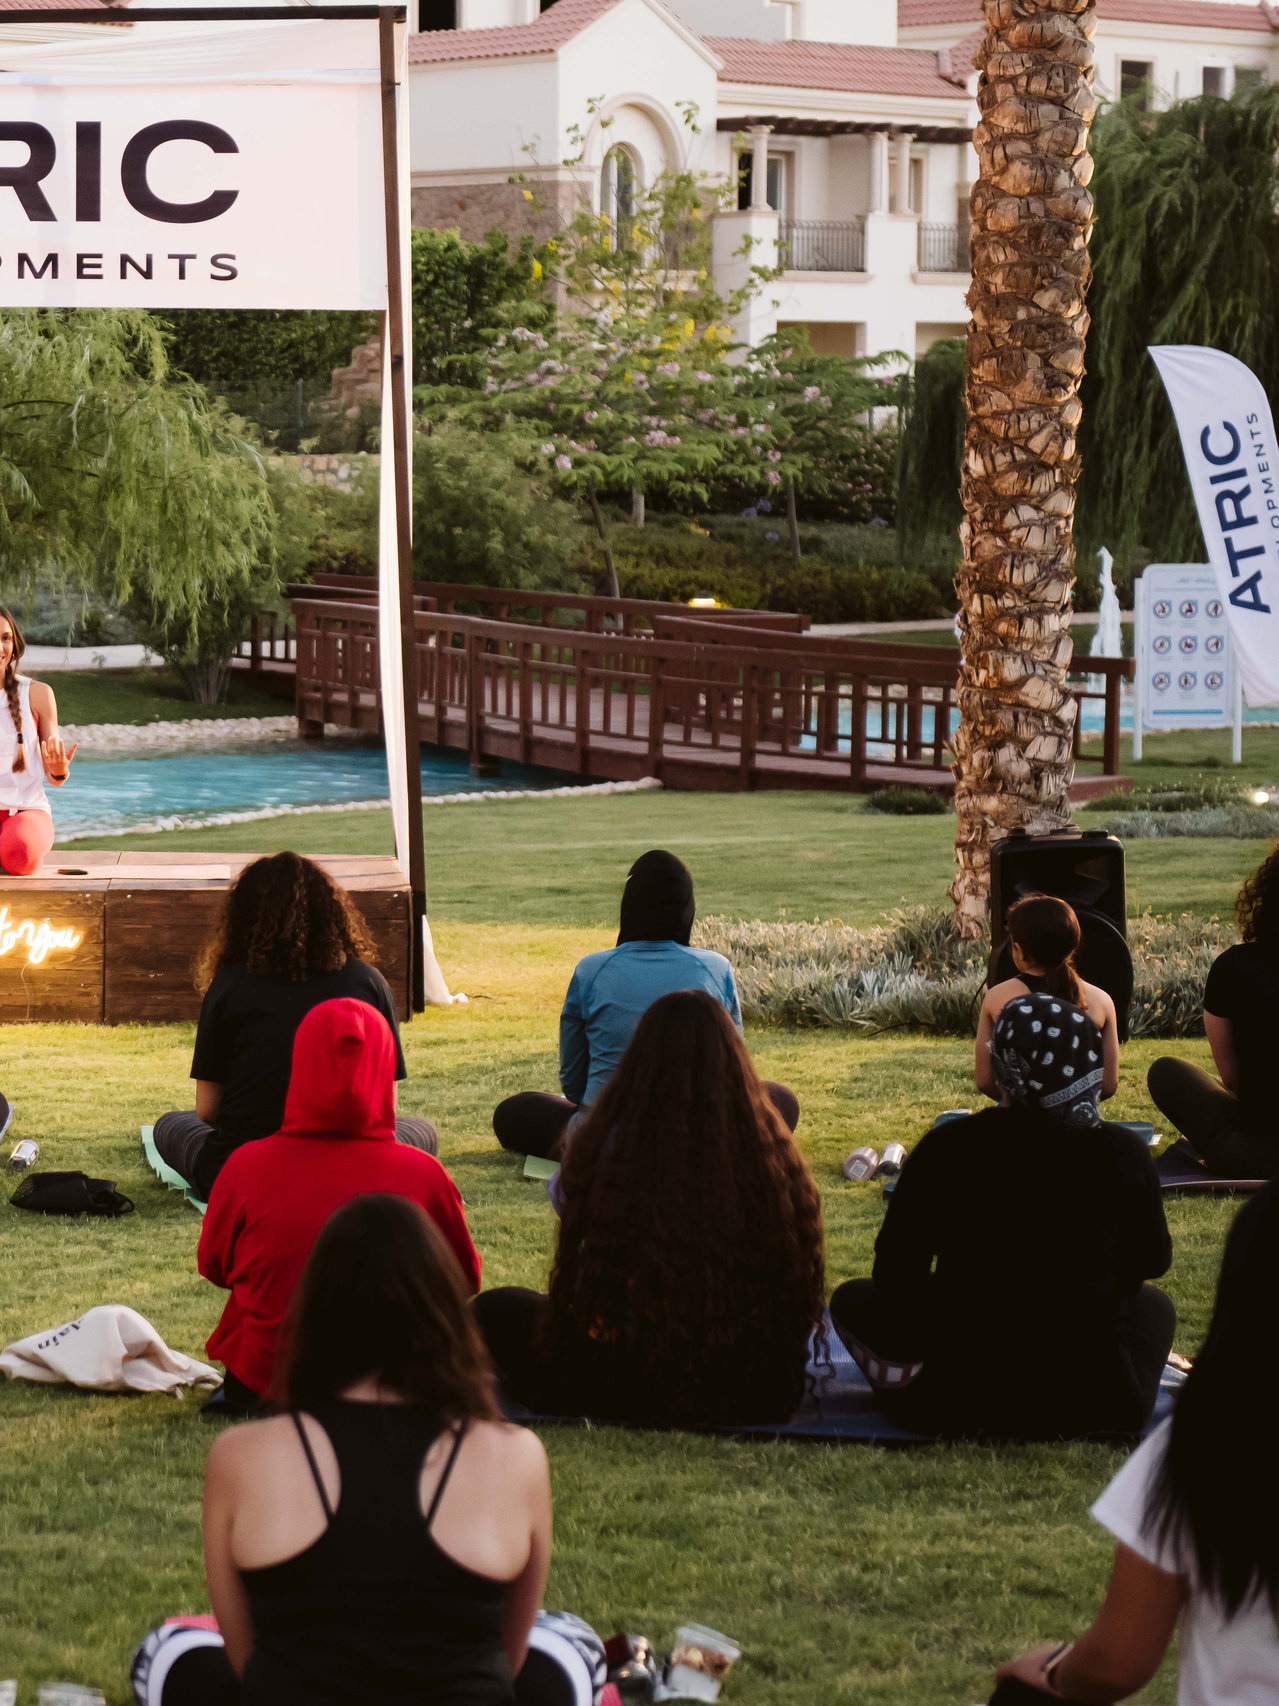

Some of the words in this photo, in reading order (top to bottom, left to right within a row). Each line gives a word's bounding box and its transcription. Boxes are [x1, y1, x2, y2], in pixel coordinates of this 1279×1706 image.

[1200, 420, 1272, 614] ATRIC
[1246, 412, 1279, 560] OPMENTS
[16, 920, 80, 964] you
